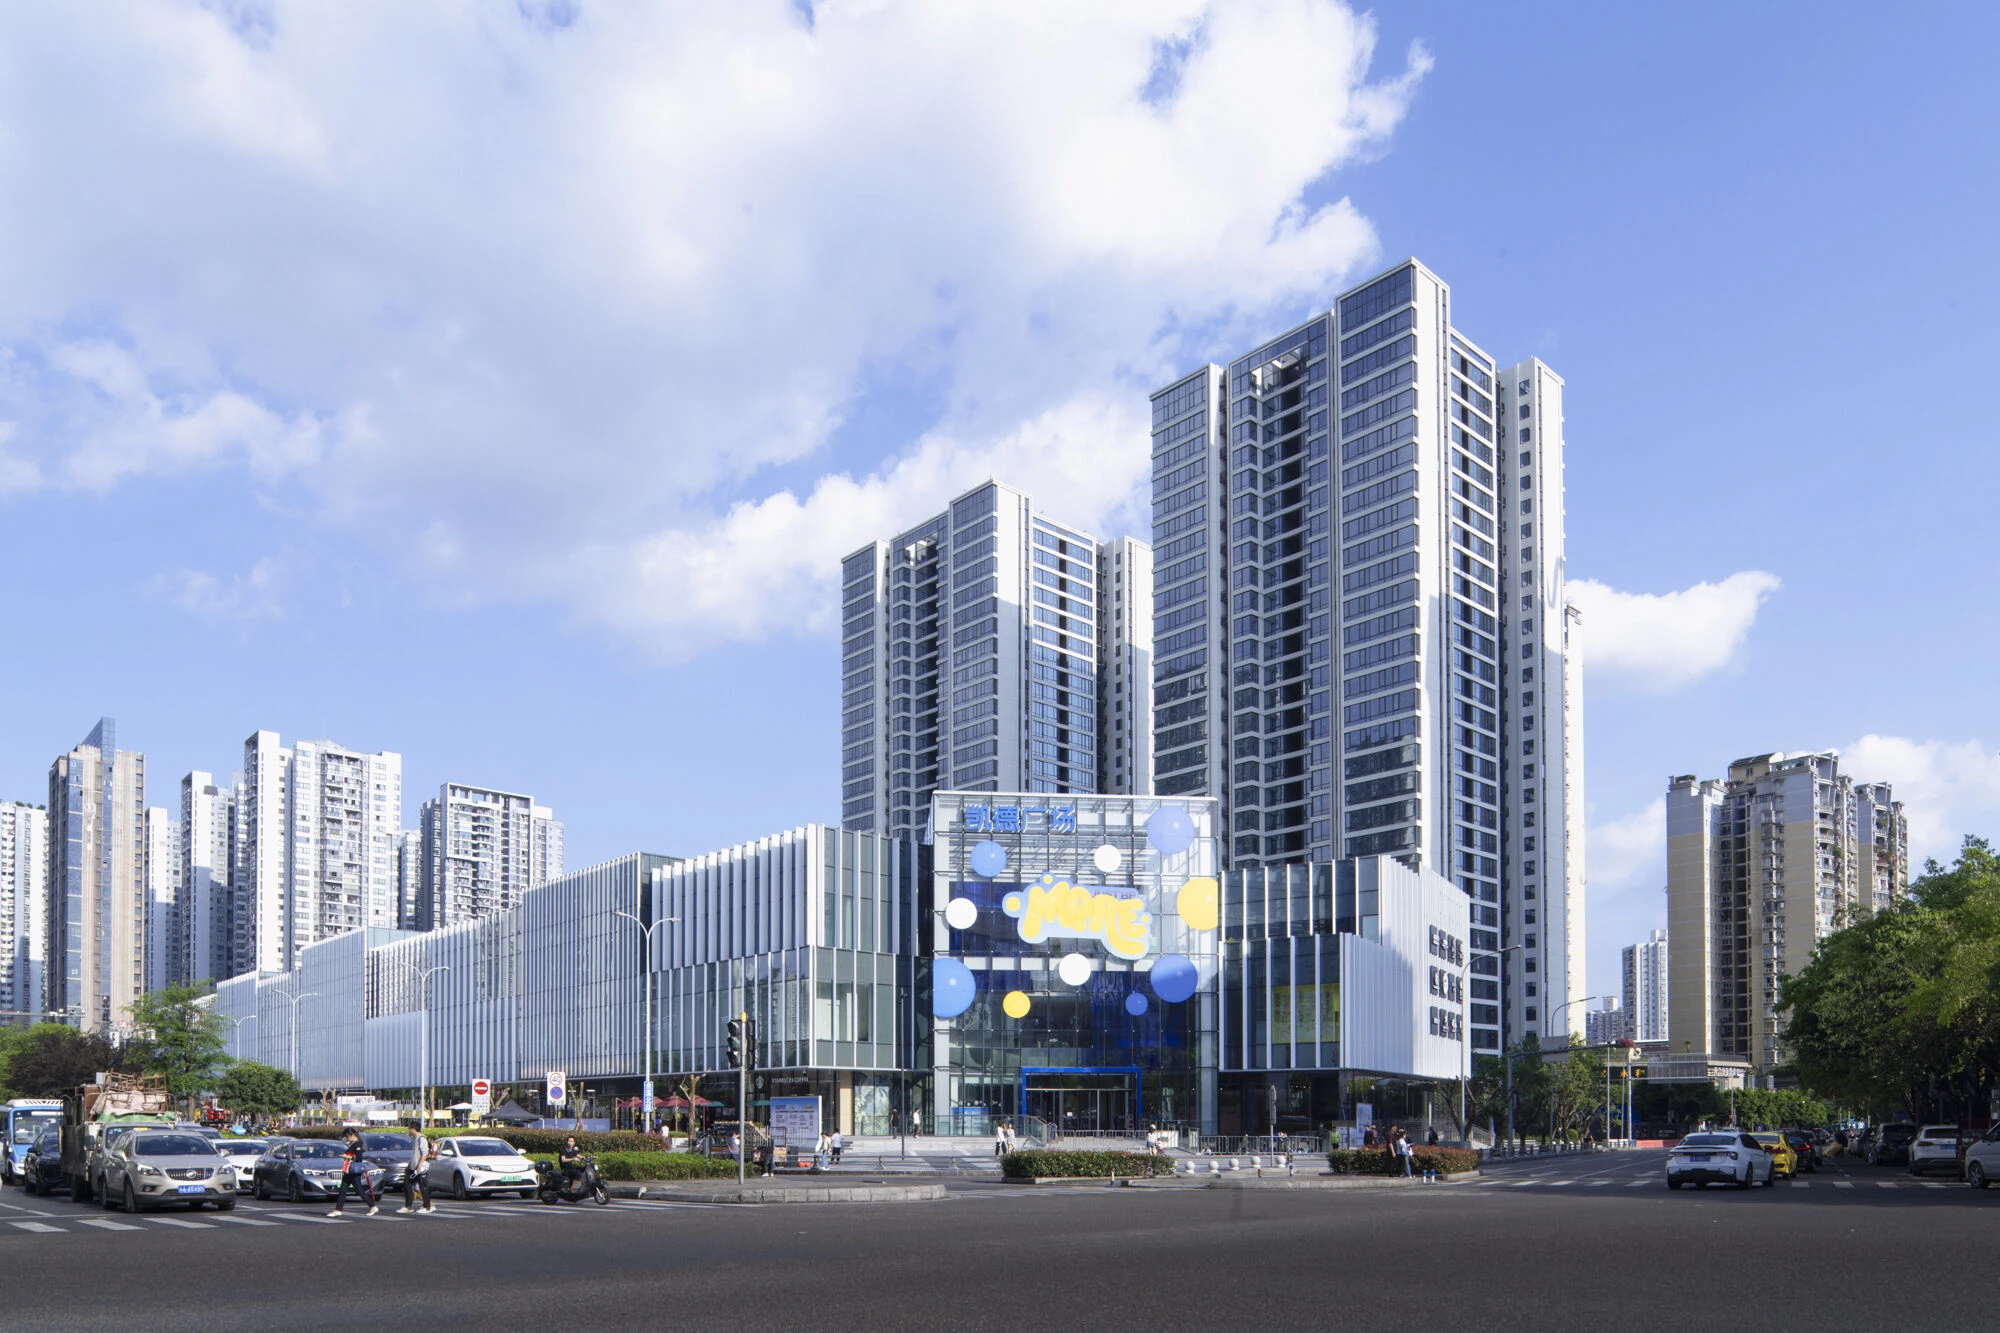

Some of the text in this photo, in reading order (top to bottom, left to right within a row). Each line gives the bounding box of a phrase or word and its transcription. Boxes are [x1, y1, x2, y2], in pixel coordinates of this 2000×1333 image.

[964, 803, 1077, 832] 凯德广场
[1023, 881, 1147, 955] MORE
